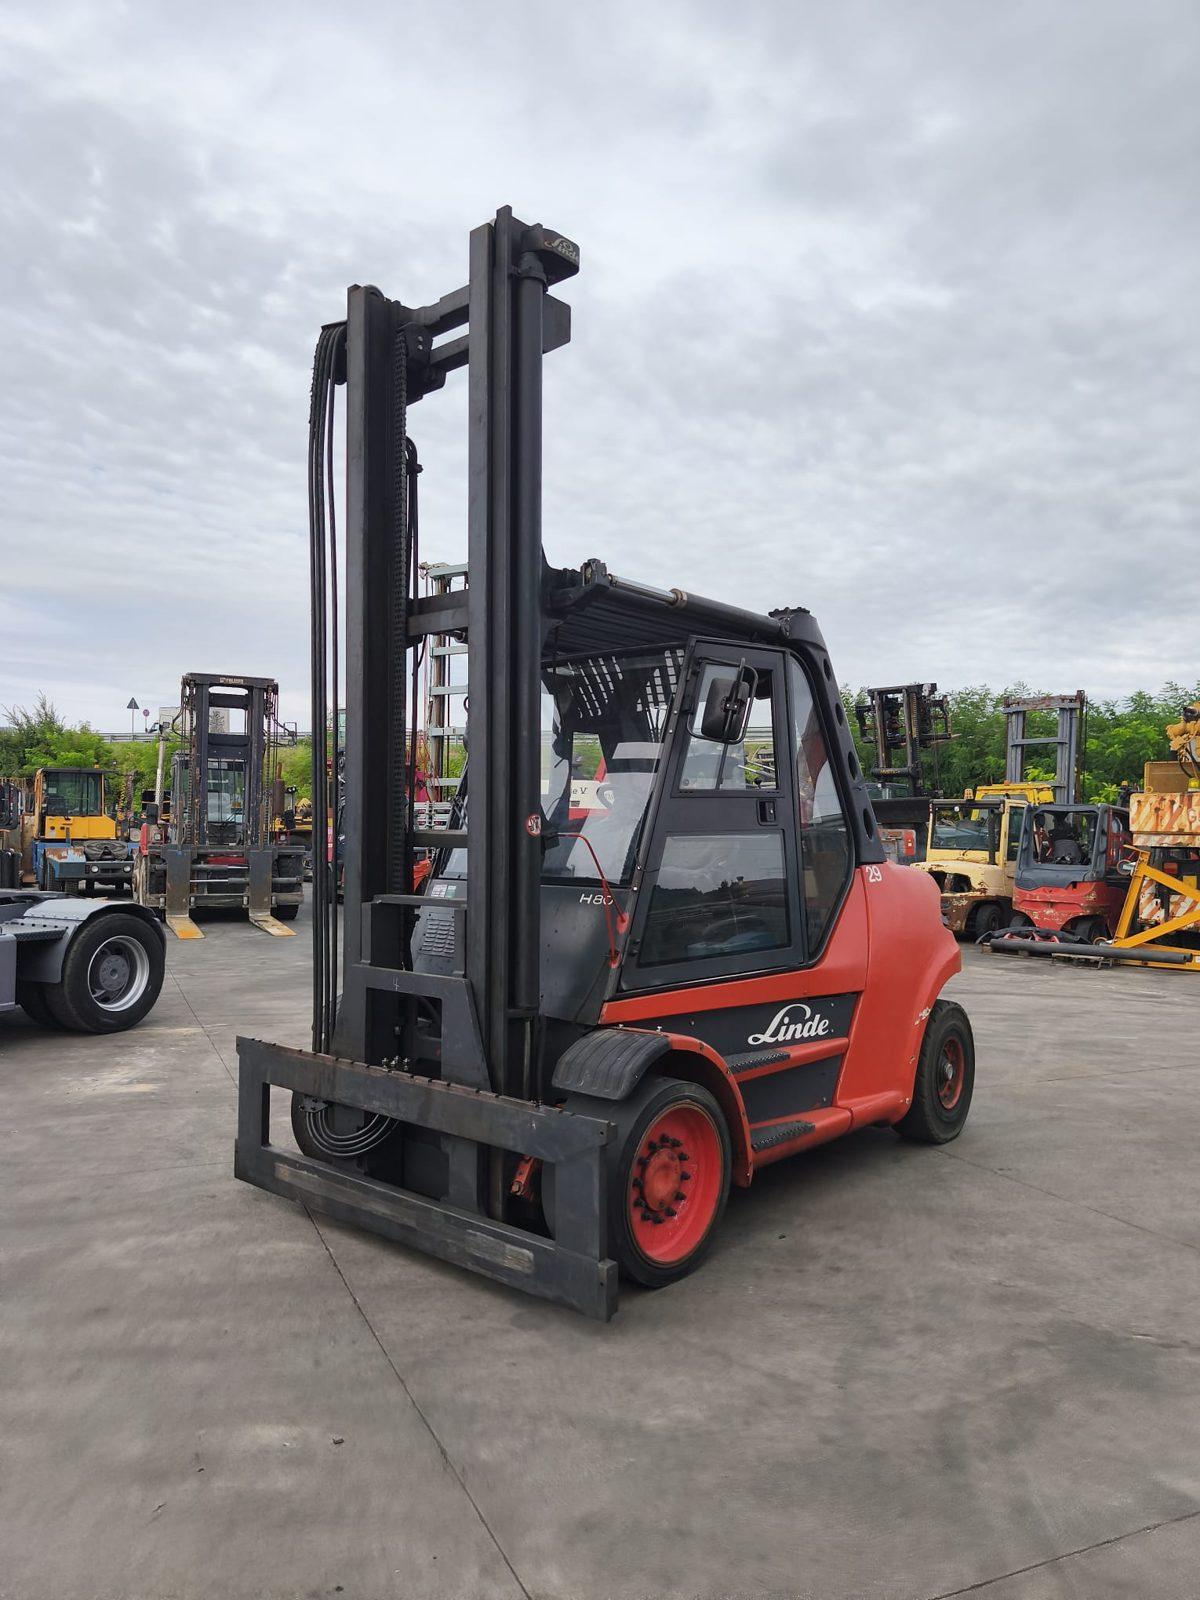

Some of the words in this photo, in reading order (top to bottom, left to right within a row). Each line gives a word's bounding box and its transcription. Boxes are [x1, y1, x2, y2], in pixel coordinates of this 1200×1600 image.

[866, 865, 882, 882] 29
[580, 893, 614, 905] H80
[747, 1003, 829, 1045] Linde
